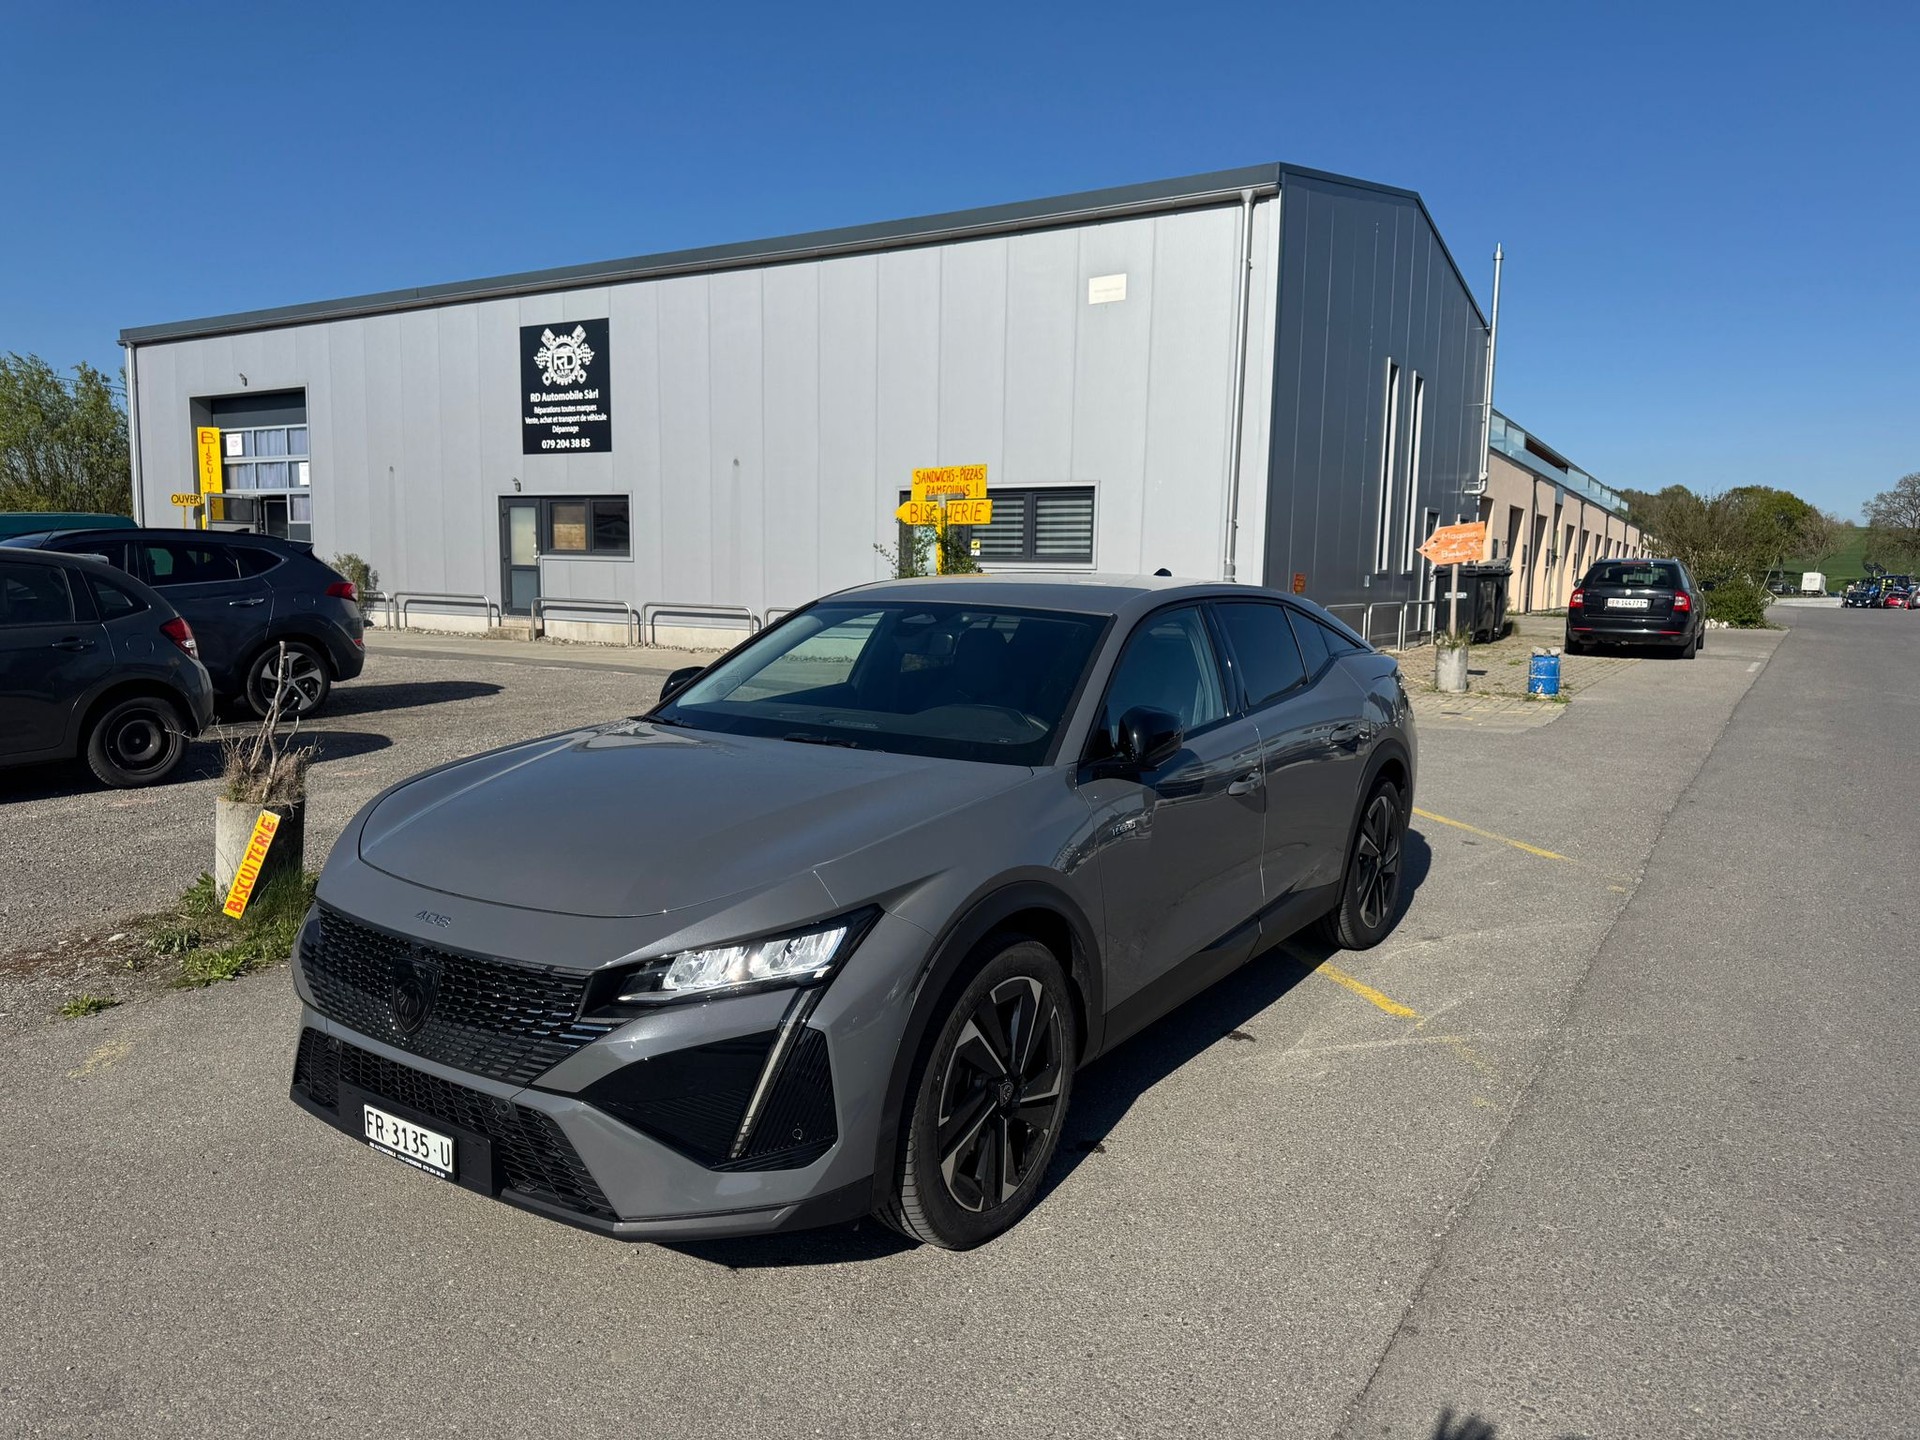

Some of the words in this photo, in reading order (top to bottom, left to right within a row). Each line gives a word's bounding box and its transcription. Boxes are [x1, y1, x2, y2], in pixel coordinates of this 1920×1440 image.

[553, 353, 576, 370] RD
[530, 393, 541, 402] RD
[541, 390, 584, 402] Automobile
[533, 405, 561, 415] Réparations
[561, 405, 576, 413] toutes
[576, 404, 597, 413] marques
[524, 416, 540, 424] Vente,
[539, 415, 553, 424] achat
[558, 414, 580, 424] transport
[580, 413, 587, 422] de
[552, 425, 580, 434] Dépannage
[541, 439, 556, 449] 079
[556, 439, 570, 448] 204
[570, 438, 580, 448] 38
[581, 438, 591, 448] 85
[171, 494, 202, 505] OUVERT
[226, 814, 277, 913] BISCUITERIE
[413, 910, 452, 928] 408
